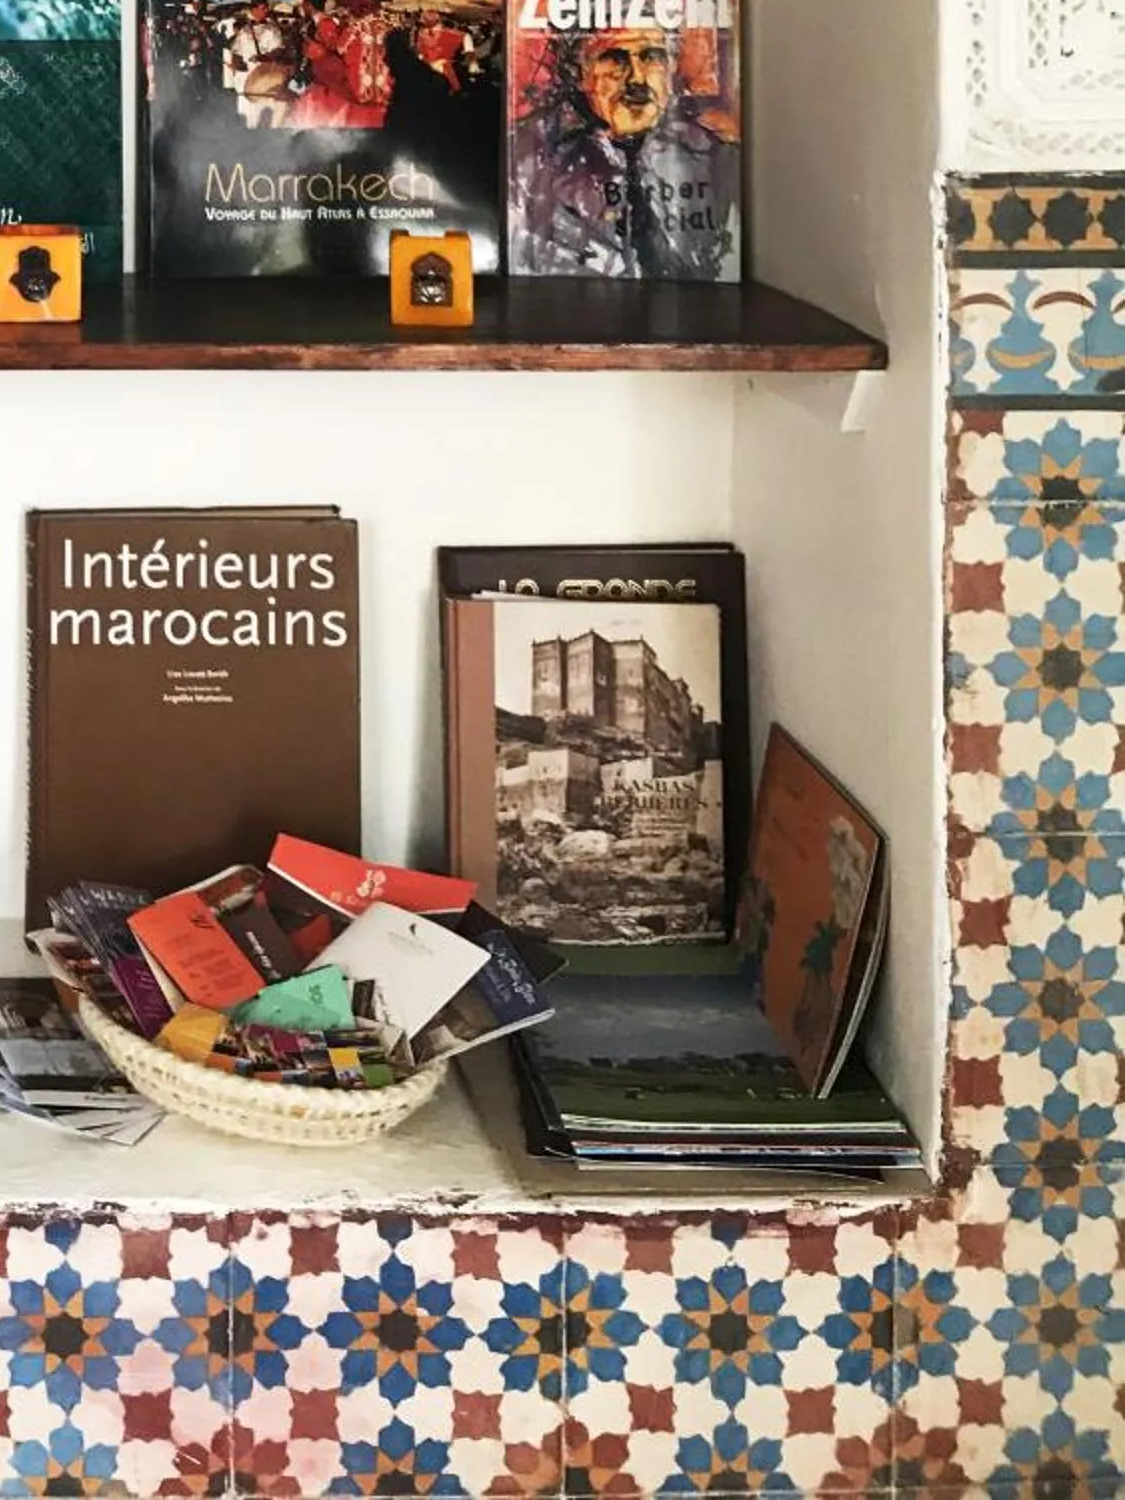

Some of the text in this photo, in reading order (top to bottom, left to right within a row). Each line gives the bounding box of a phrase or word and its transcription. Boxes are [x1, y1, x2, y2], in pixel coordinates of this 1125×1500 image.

[204, 163, 435, 202] Marrakech
[63, 538, 335, 590] Intérieurs
[49, 596, 349, 647] marocains
[614, 779, 695, 793] KASBAS
